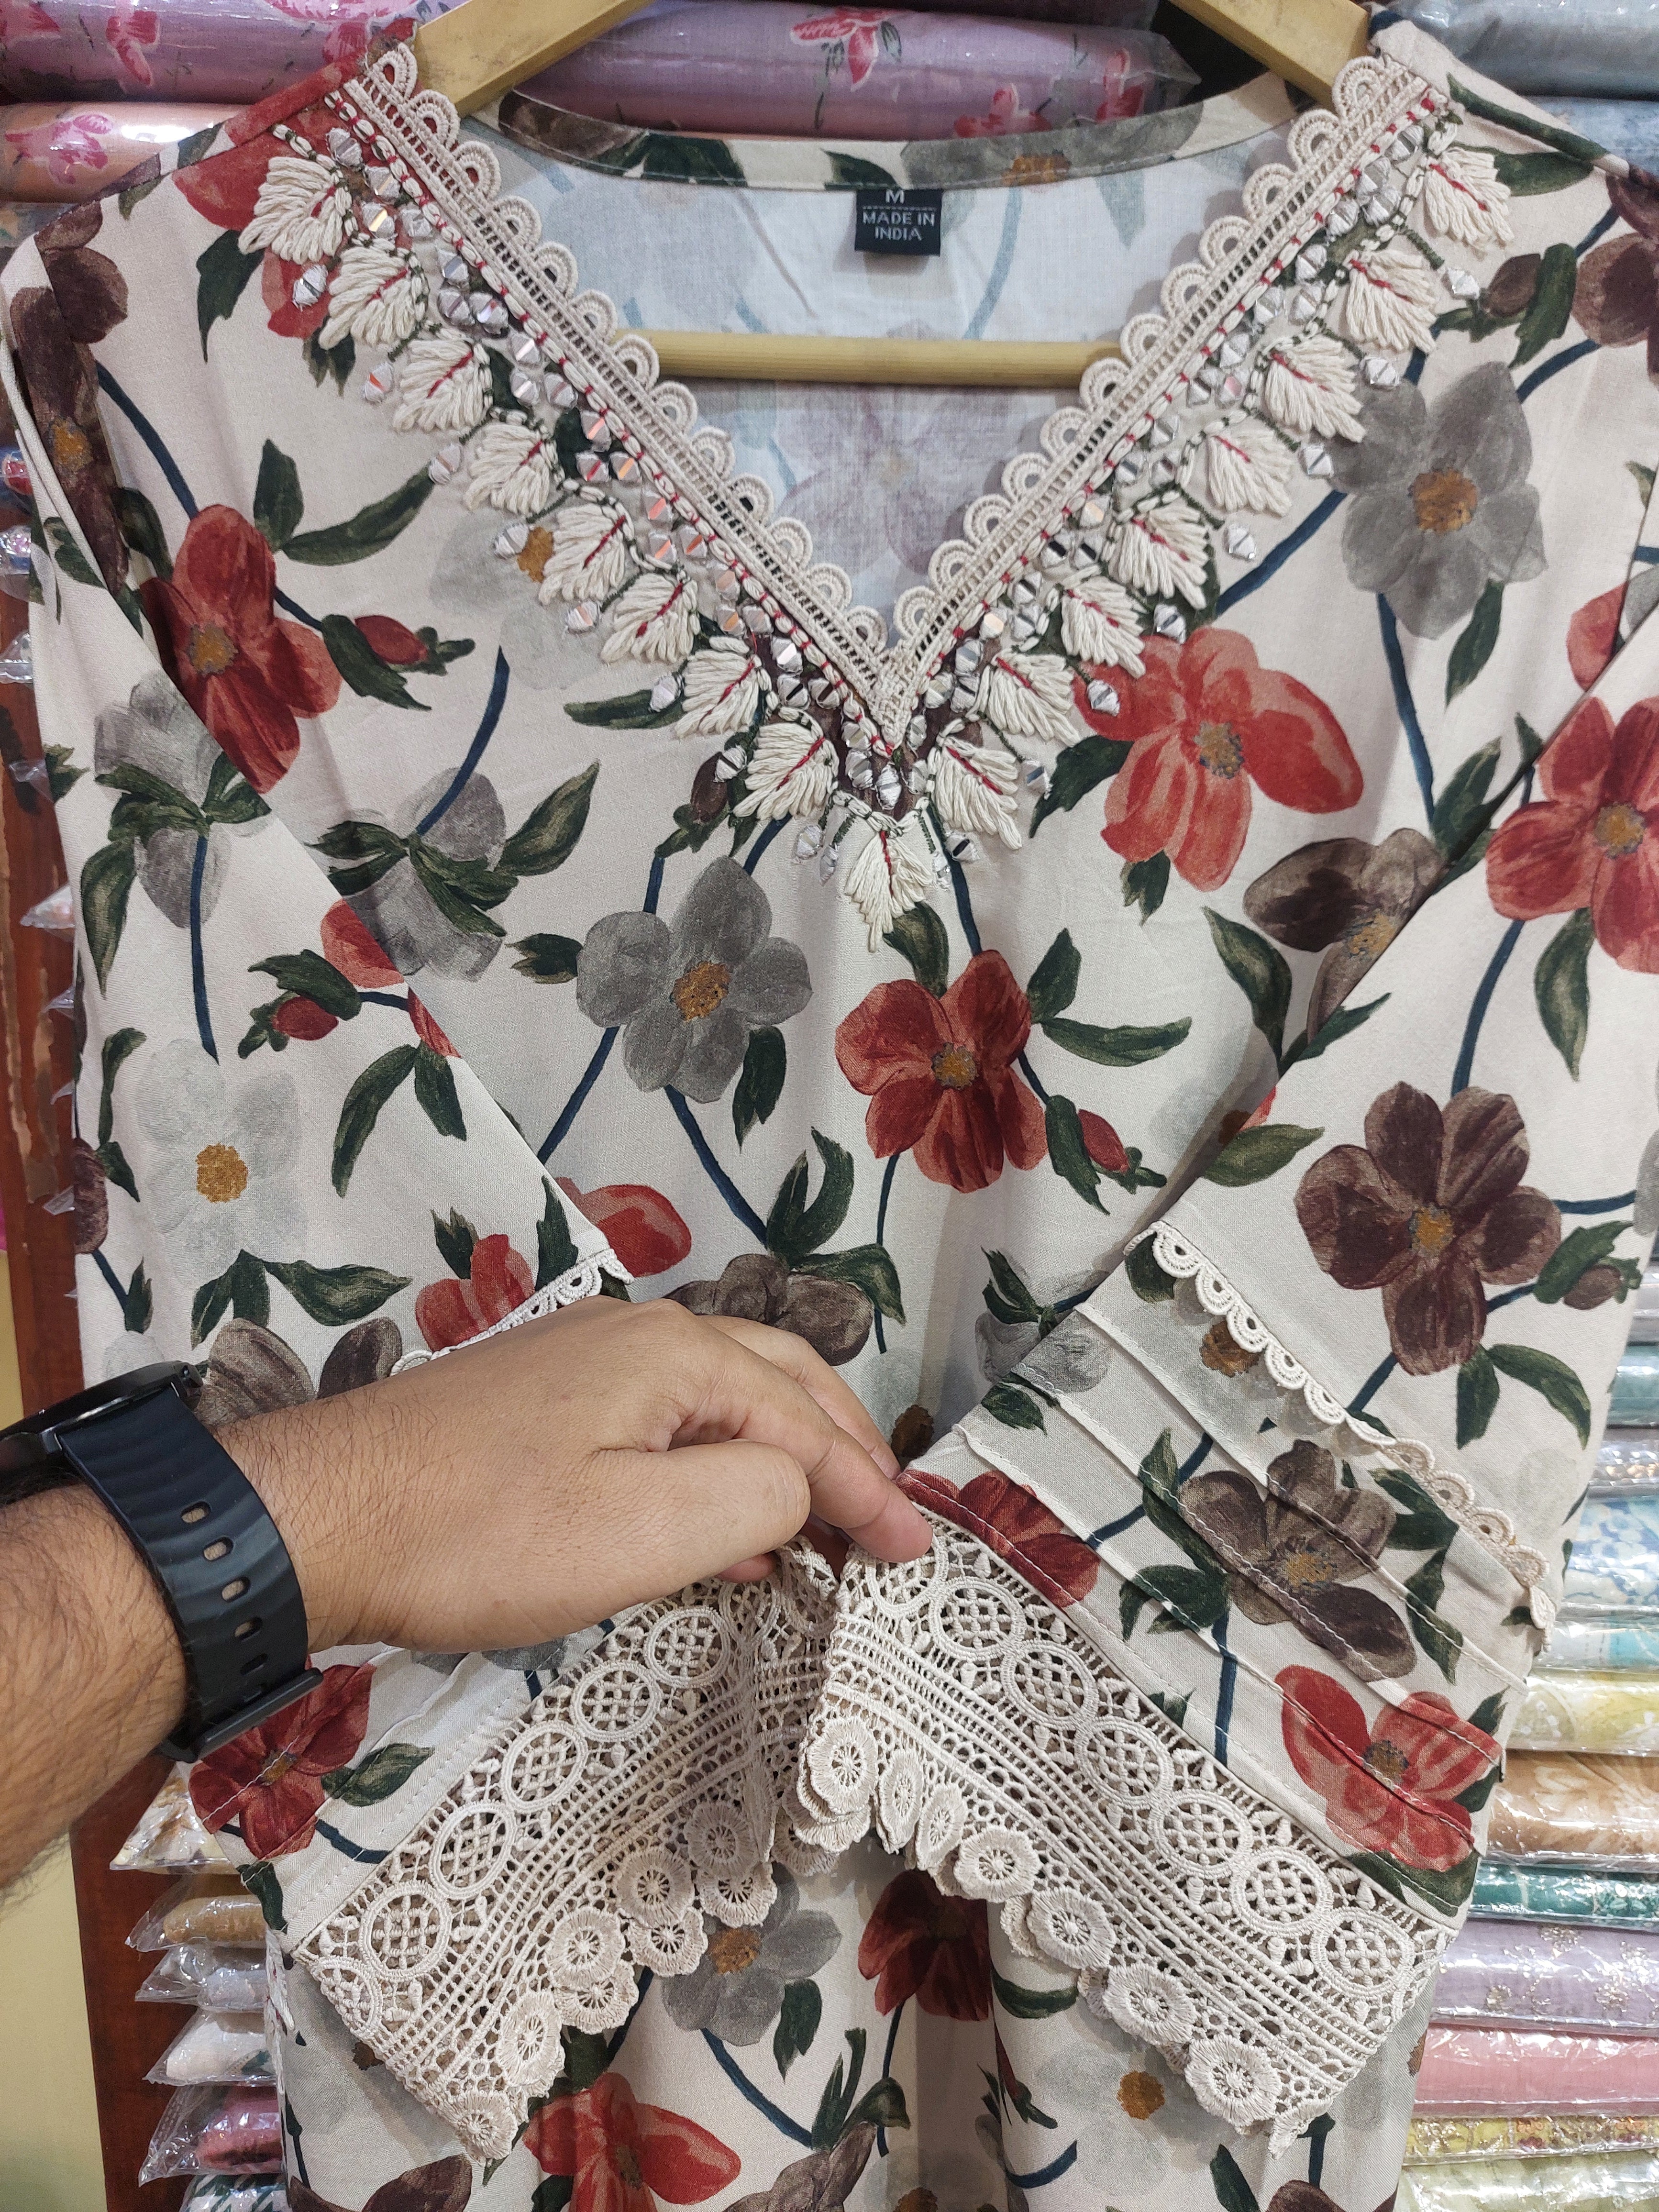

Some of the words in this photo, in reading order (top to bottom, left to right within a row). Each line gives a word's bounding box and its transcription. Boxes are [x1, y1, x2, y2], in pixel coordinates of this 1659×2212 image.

[885, 189, 905, 203] M
[863, 211, 912, 225] MADE
[918, 212, 935, 227] IN
[875, 226, 923, 241] INDIA
